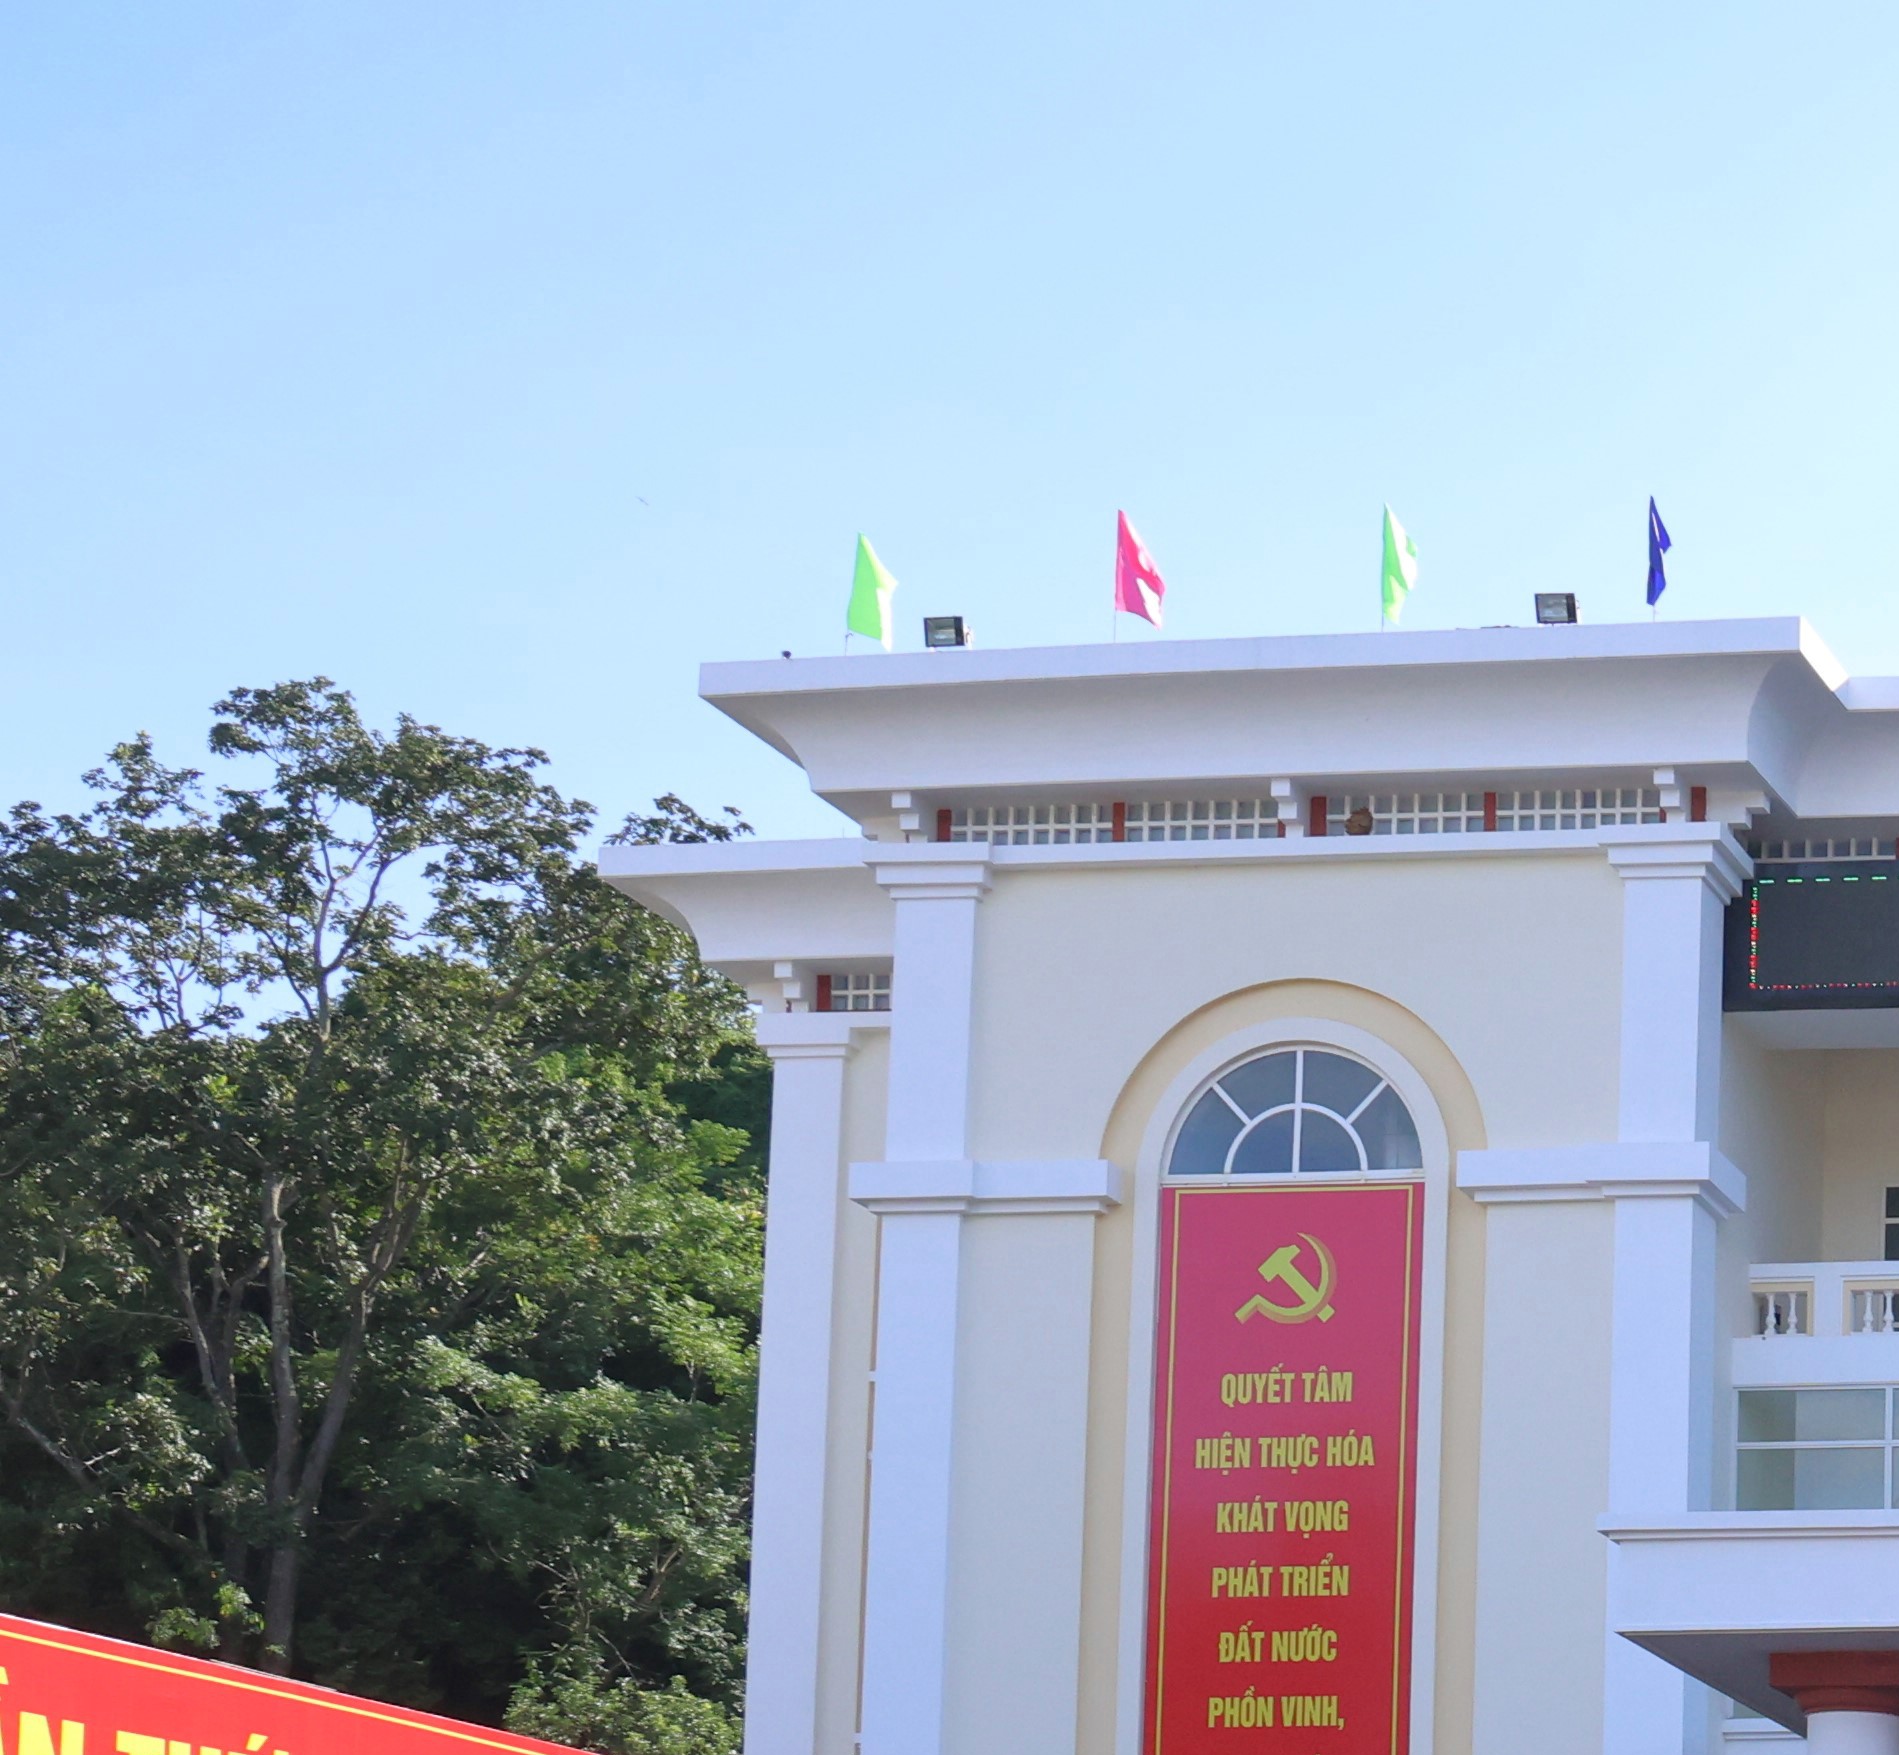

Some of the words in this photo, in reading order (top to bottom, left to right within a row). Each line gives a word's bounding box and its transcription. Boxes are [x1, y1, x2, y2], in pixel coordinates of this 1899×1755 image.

[1221, 1363, 1295, 1407] QUYẾT
[1302, 1366, 1352, 1402] TÂM
[1196, 1432, 1250, 1475] HIỆN
[1258, 1434, 1319, 1473] THỰC
[1327, 1430, 1374, 1466] HÓA
[1217, 1496, 1277, 1532] KHÁT
[1285, 1500, 1348, 1538] VỌNG
[1212, 1560, 1273, 1597] PHÁT
[1280, 1553, 1349, 1596] TRIỂN
[1219, 1621, 1264, 1662] ĐẤT
[1272, 1624, 1337, 1661] NƯỚC
[1208, 1686, 1274, 1727] PHỒN
[1281, 1696, 1344, 1730] VINH,
